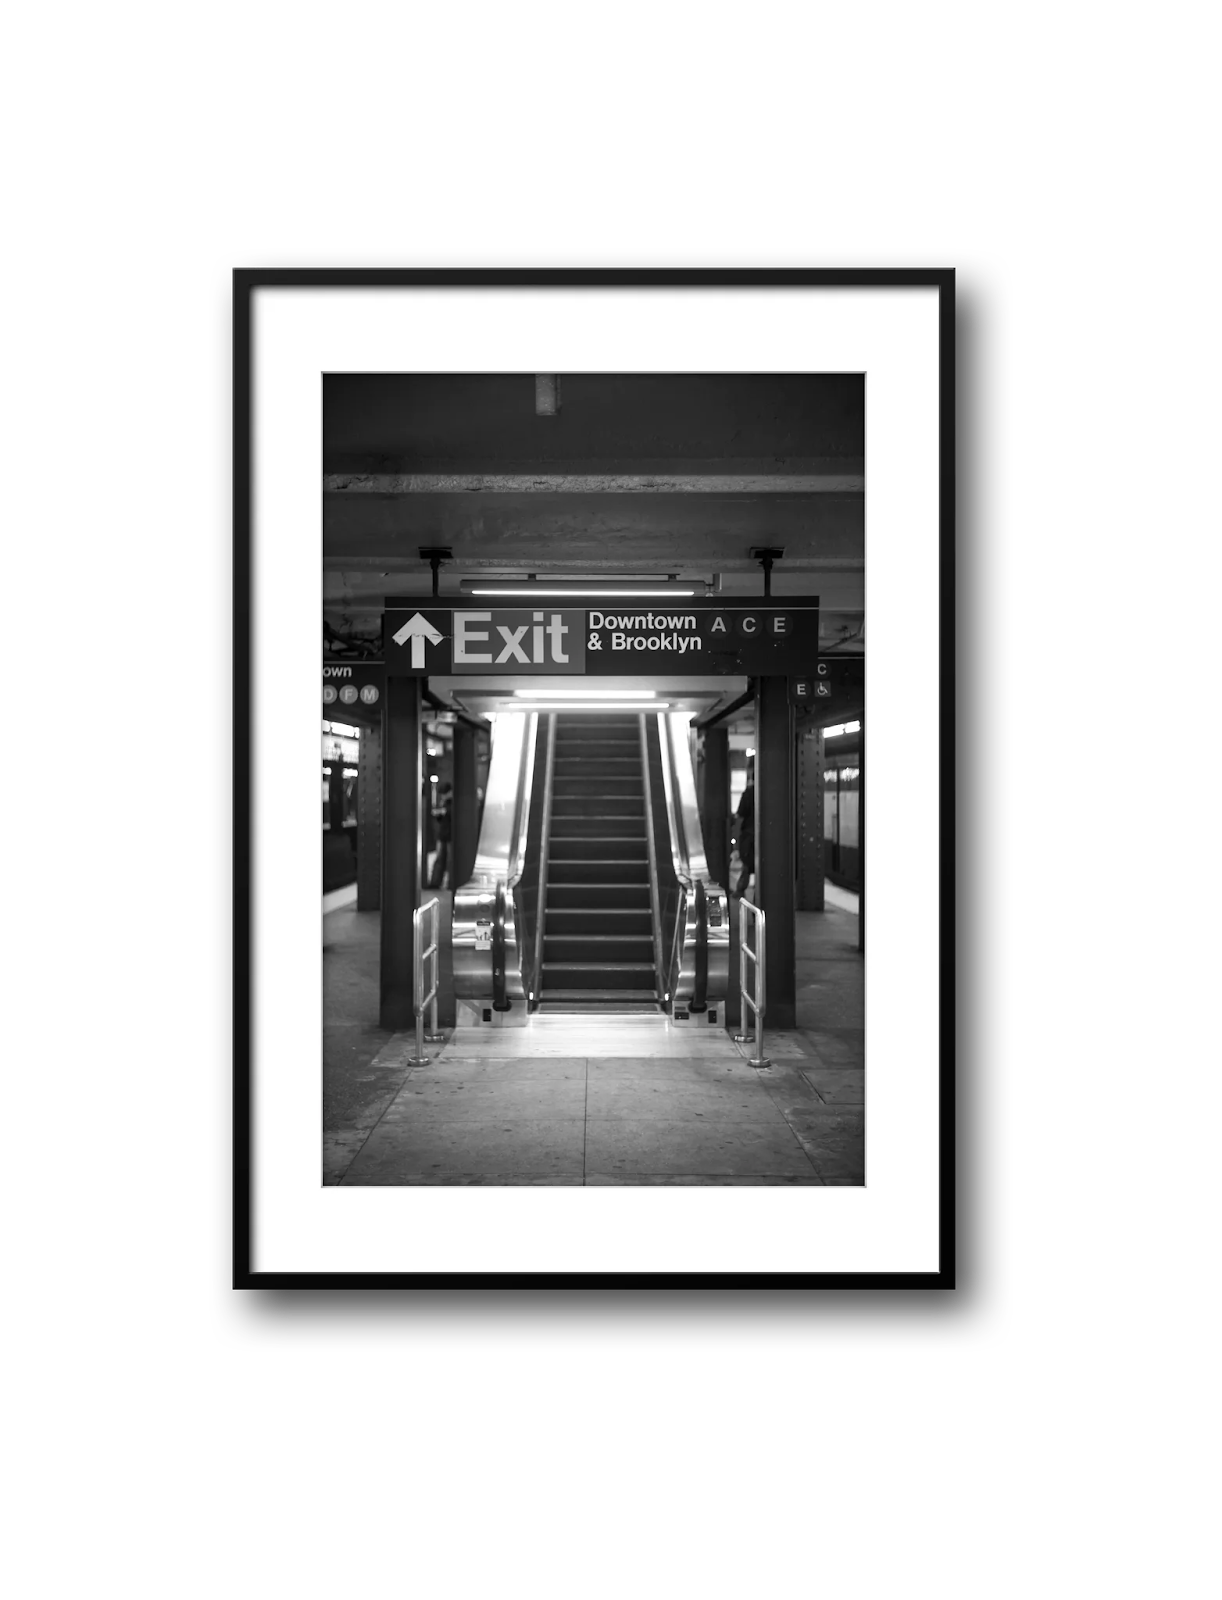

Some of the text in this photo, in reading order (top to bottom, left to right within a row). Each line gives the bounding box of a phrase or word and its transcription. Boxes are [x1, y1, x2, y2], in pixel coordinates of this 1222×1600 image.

[588, 611, 697, 630] Downtown
[710, 616, 787, 633] A C E
[453, 611, 570, 664] Exit
[587, 632, 702, 654] & Brooklyn
[323, 666, 352, 678] own
[817, 663, 827, 675] C
[324, 688, 376, 701] D F M
[796, 683, 807, 695] E
